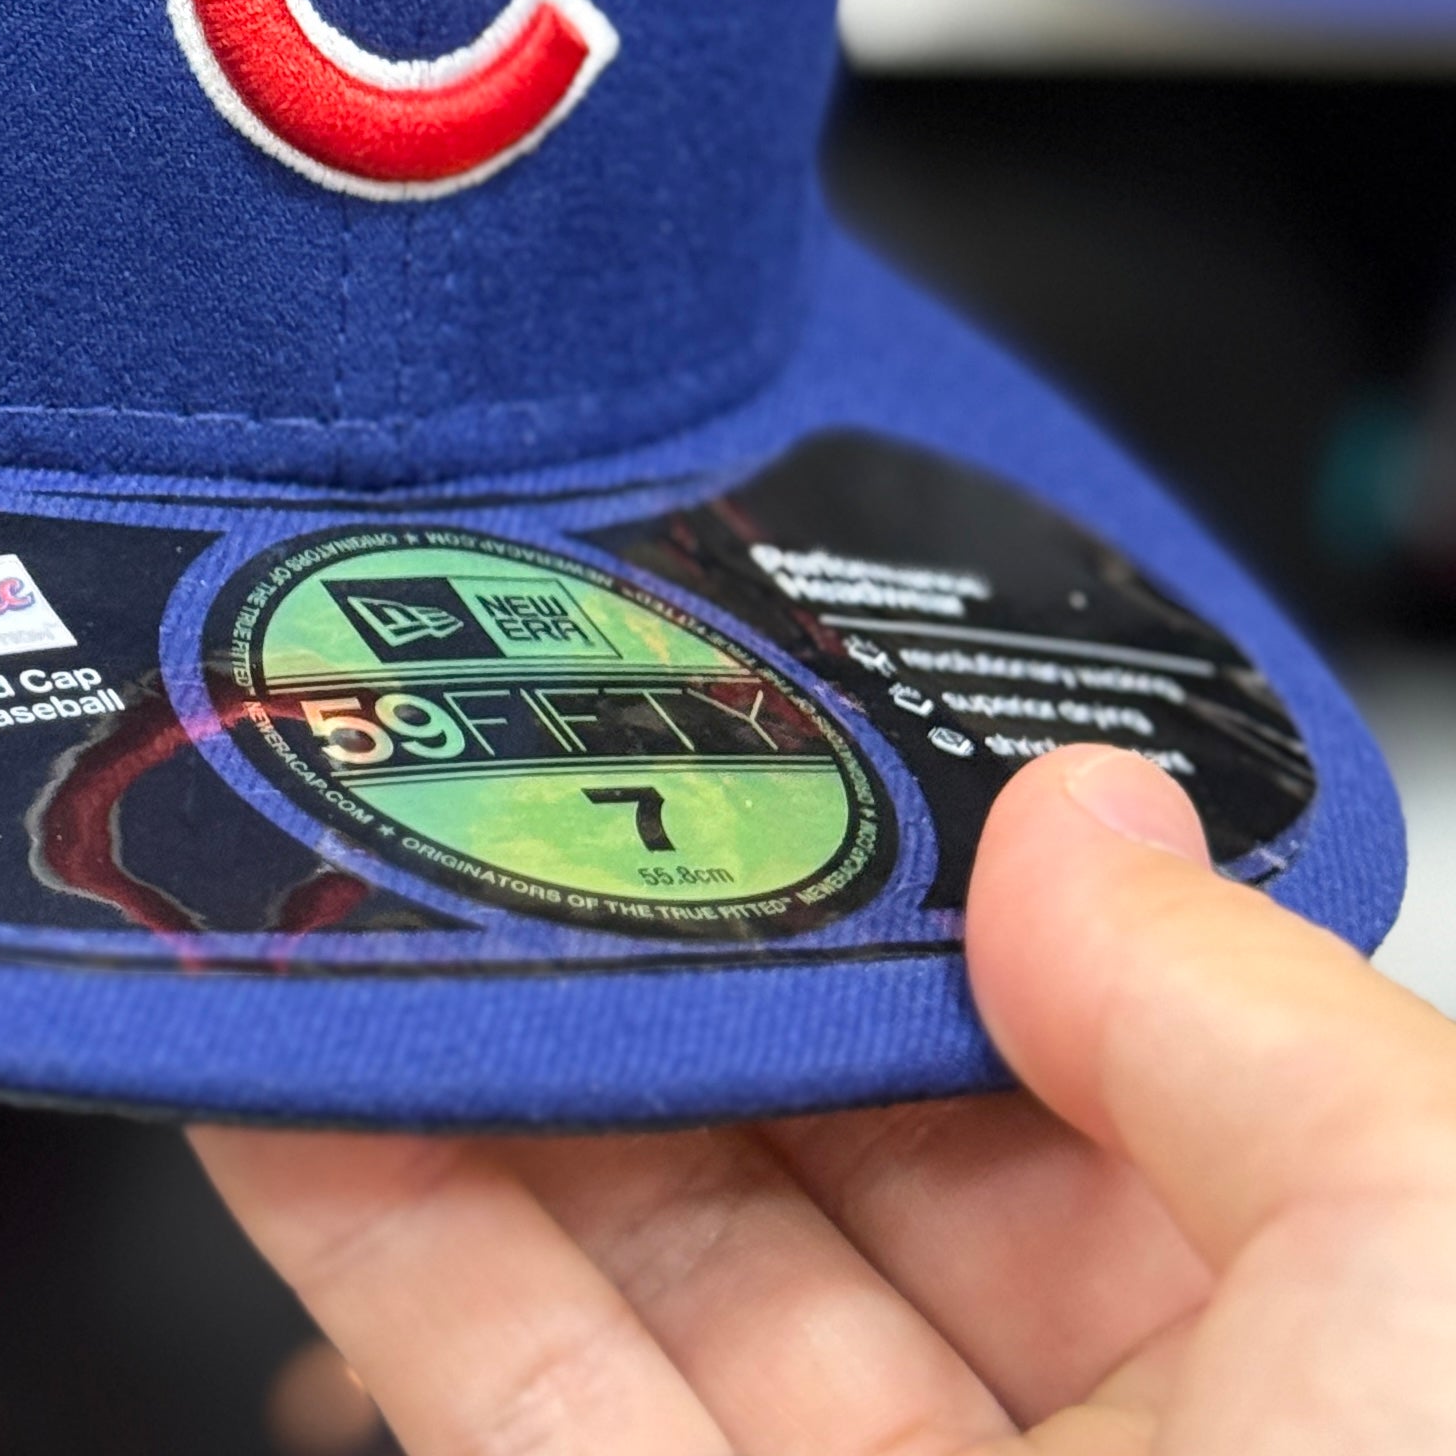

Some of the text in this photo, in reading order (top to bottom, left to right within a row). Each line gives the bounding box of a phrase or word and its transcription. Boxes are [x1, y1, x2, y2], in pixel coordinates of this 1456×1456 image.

[269, 566, 292, 587] OF
[247, 581, 277, 610] THE
[474, 594, 568, 617] NEW
[496, 618, 597, 646] ERA
[19, 666, 102, 692] Cap
[300, 687, 779, 764] 59FIFTY
[244, 700, 374, 825] NEWERACAP.COM
[581, 786, 676, 852] 7
[401, 836, 562, 903] ORIGINATORS
[567, 894, 599, 910] OF
[604, 899, 654, 918] THE
[654, 905, 718, 921] TRUE
[638, 866, 735, 887] 55.8cm
